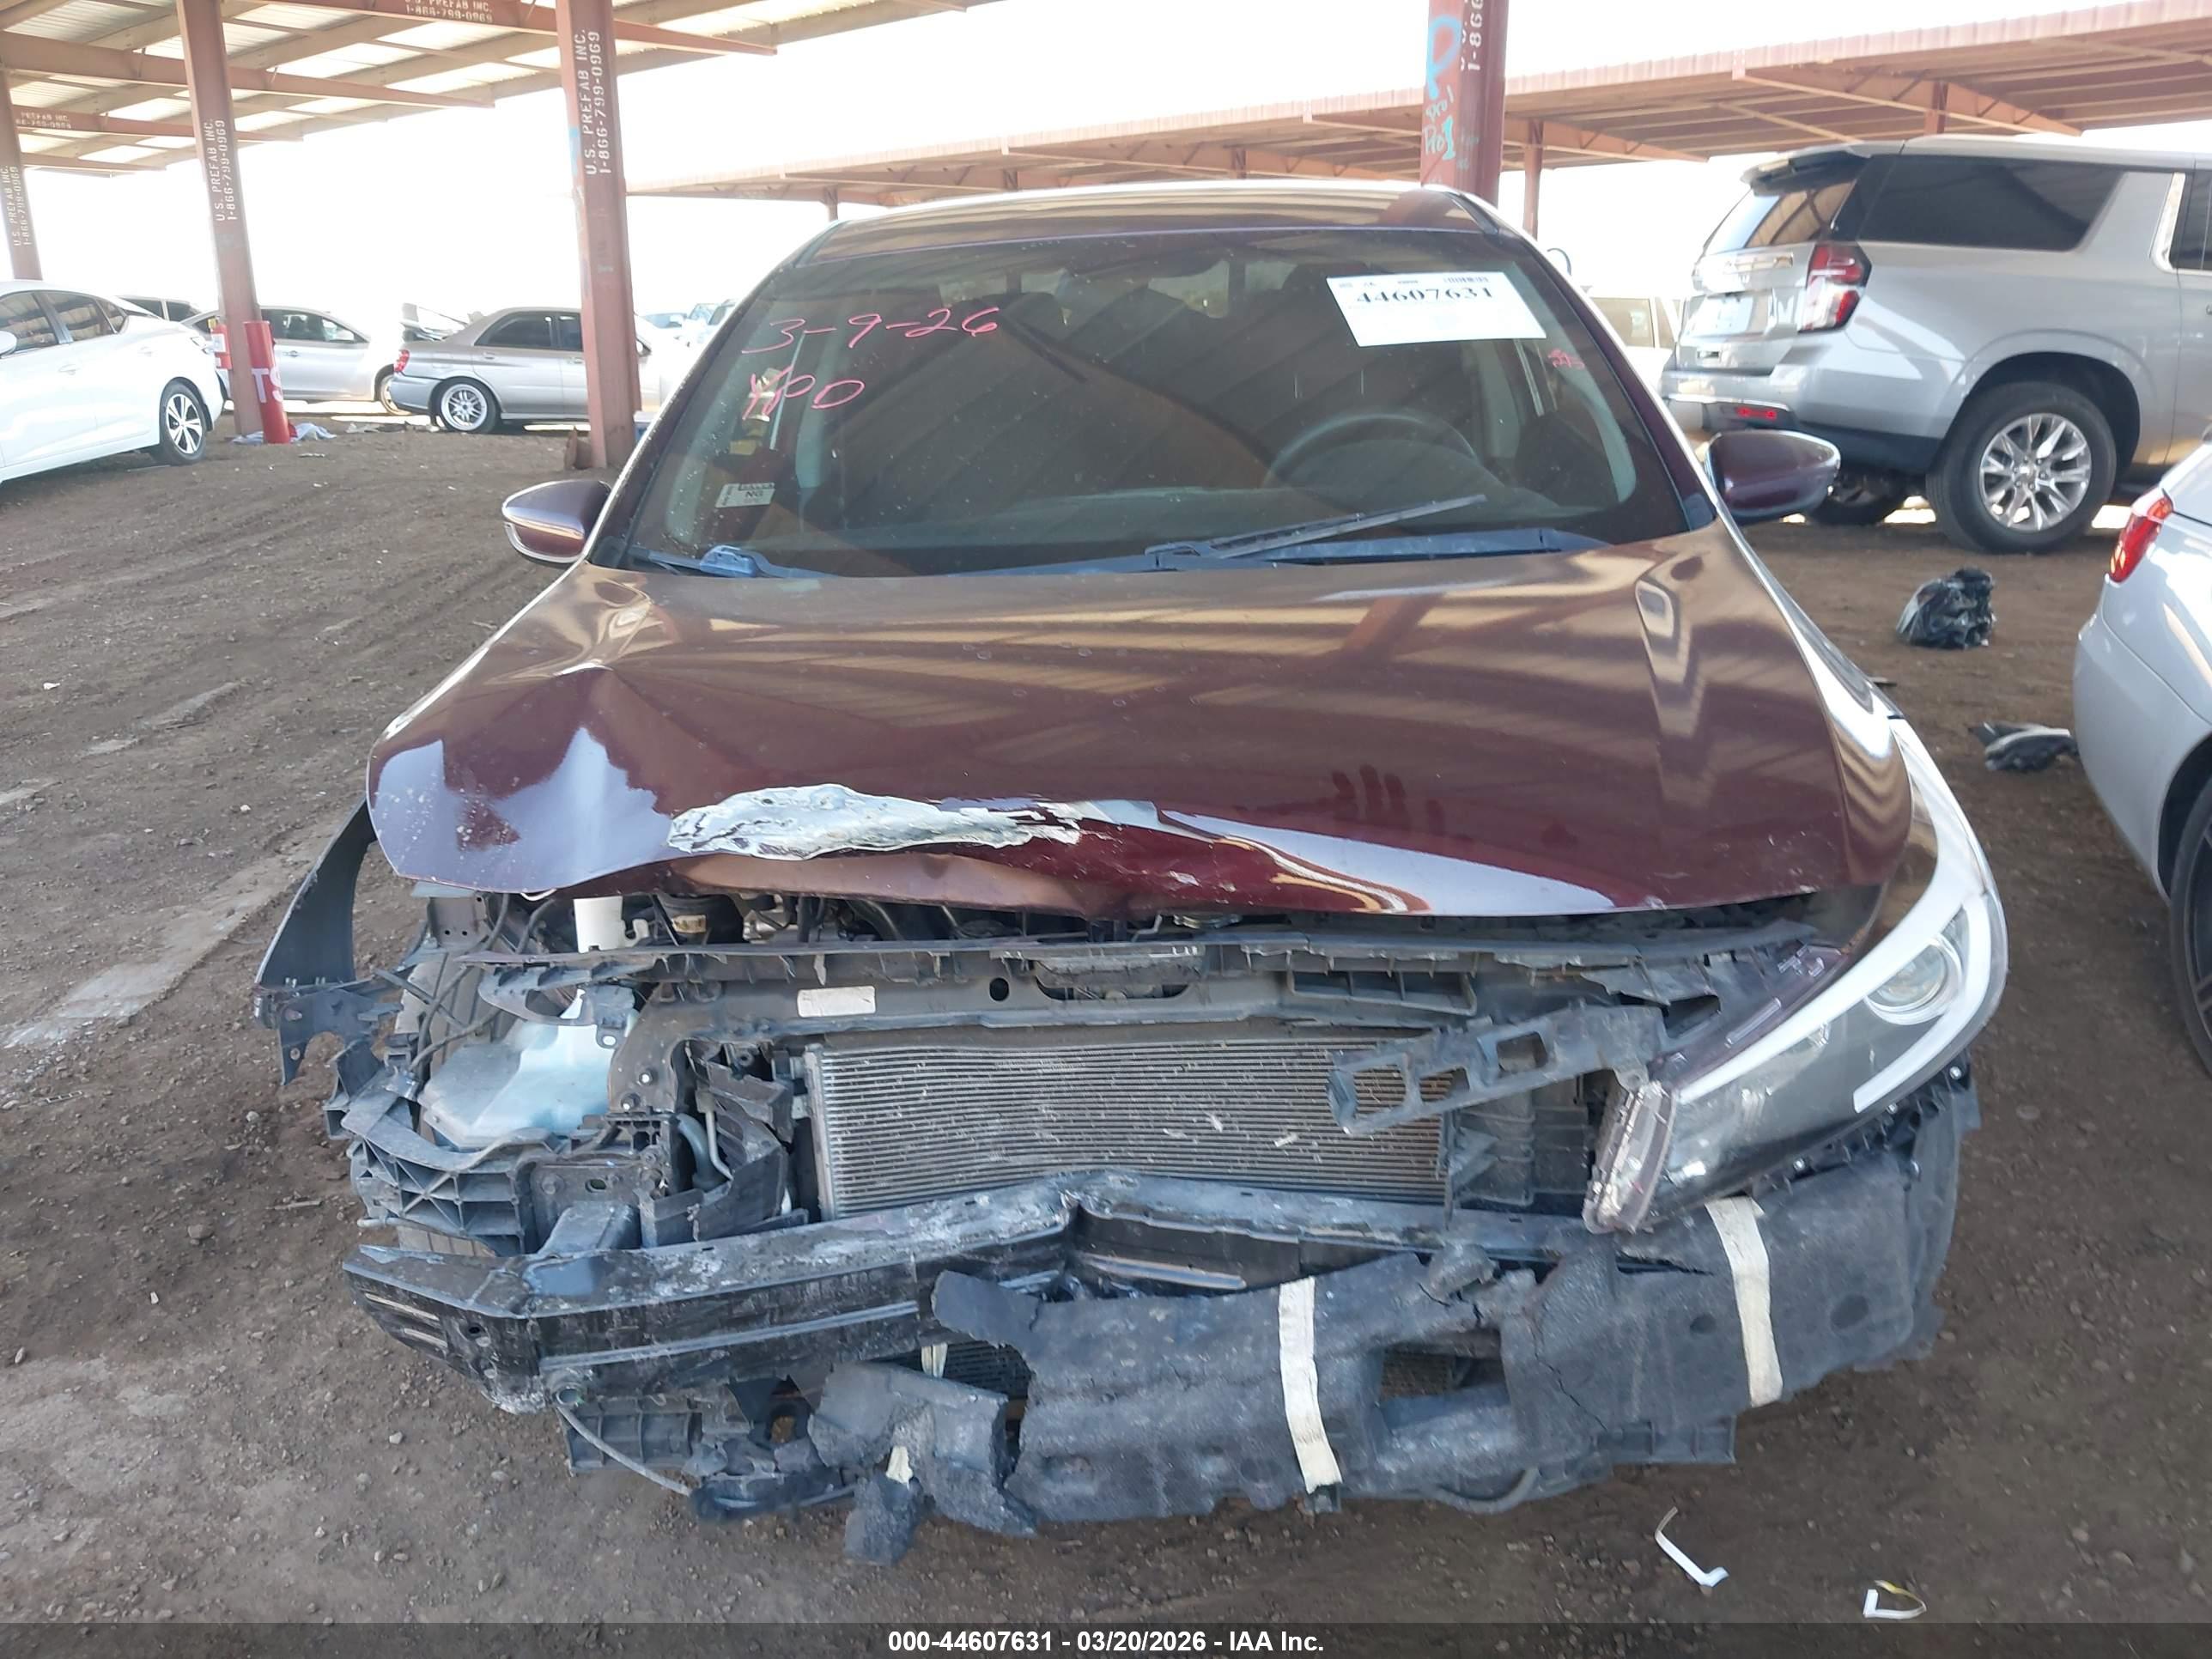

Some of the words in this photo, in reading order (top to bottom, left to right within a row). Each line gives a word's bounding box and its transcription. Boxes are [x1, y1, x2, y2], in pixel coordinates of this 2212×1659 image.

[574, 28, 588, 61] INC.
[577, 70, 595, 135] PREFAB
[587, 30, 612, 174] 1-866-799-0969
[206, 147, 223, 193] PREFAB
[215, 119, 238, 221] 1-866-799-0969
[584, 143, 598, 175] U.S.
[4, 187, 19, 225] PREFAB
[1356, 286, 1493, 303] 44607631
[741, 307, 1000, 354] 3-9-26
